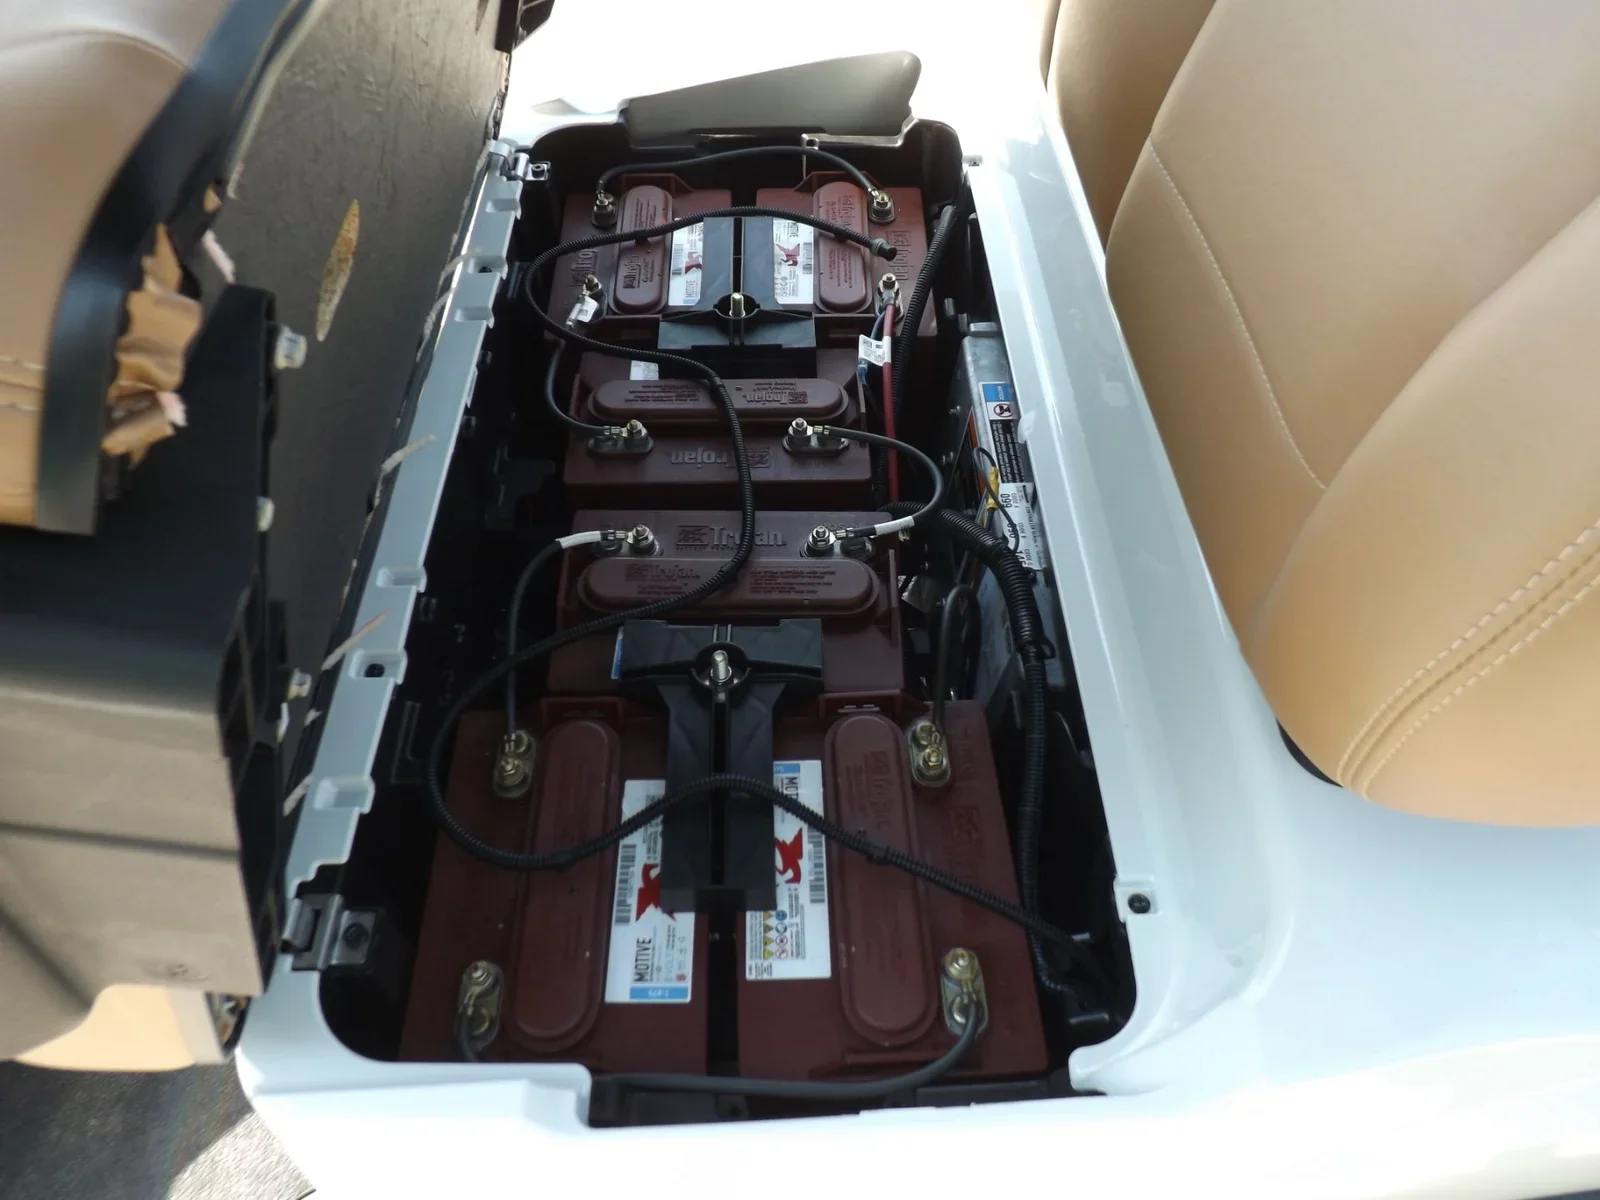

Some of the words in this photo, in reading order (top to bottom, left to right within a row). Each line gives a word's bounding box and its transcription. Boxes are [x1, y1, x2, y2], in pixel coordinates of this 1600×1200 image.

[888, 248, 914, 281] Trojan
[746, 393, 788, 405] Trojan
[1000, 493, 1013, 508] 099
[710, 525, 784, 546] Tran
[633, 937, 652, 982] MOTIVE
